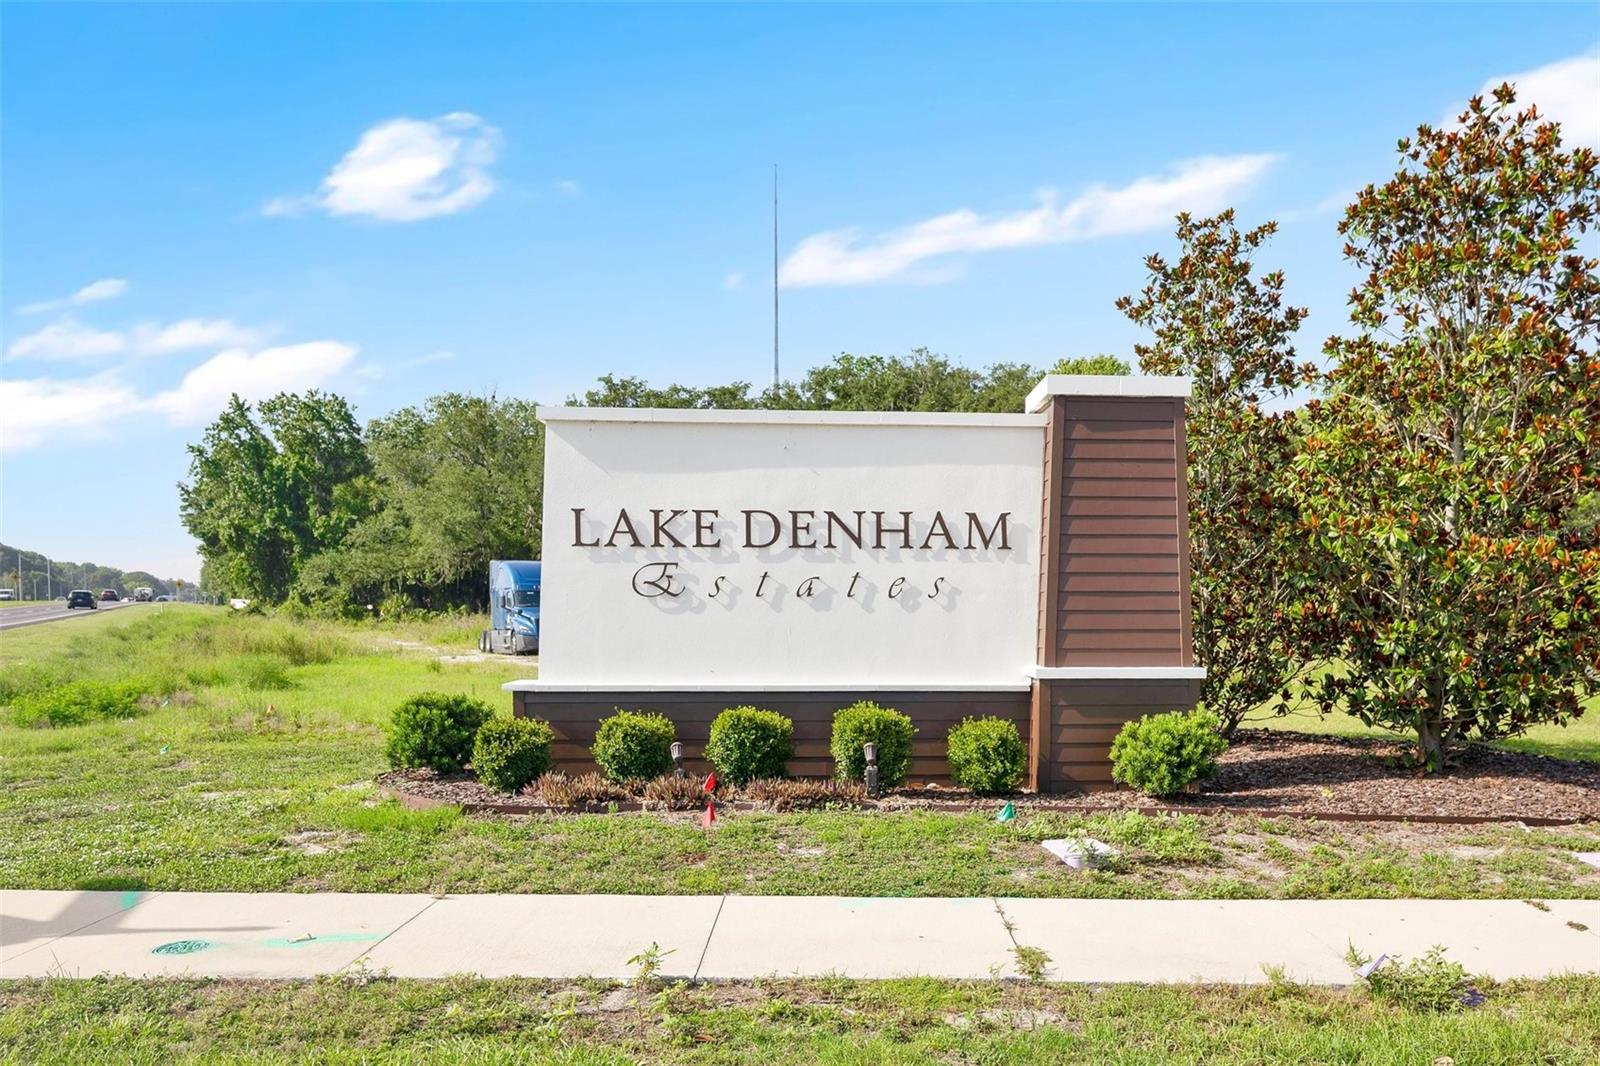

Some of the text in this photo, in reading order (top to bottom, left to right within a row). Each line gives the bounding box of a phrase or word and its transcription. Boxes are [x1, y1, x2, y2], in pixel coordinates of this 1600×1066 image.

[571, 507, 1012, 550] LAKE DENHAM
[632, 562, 945, 599] Estates
